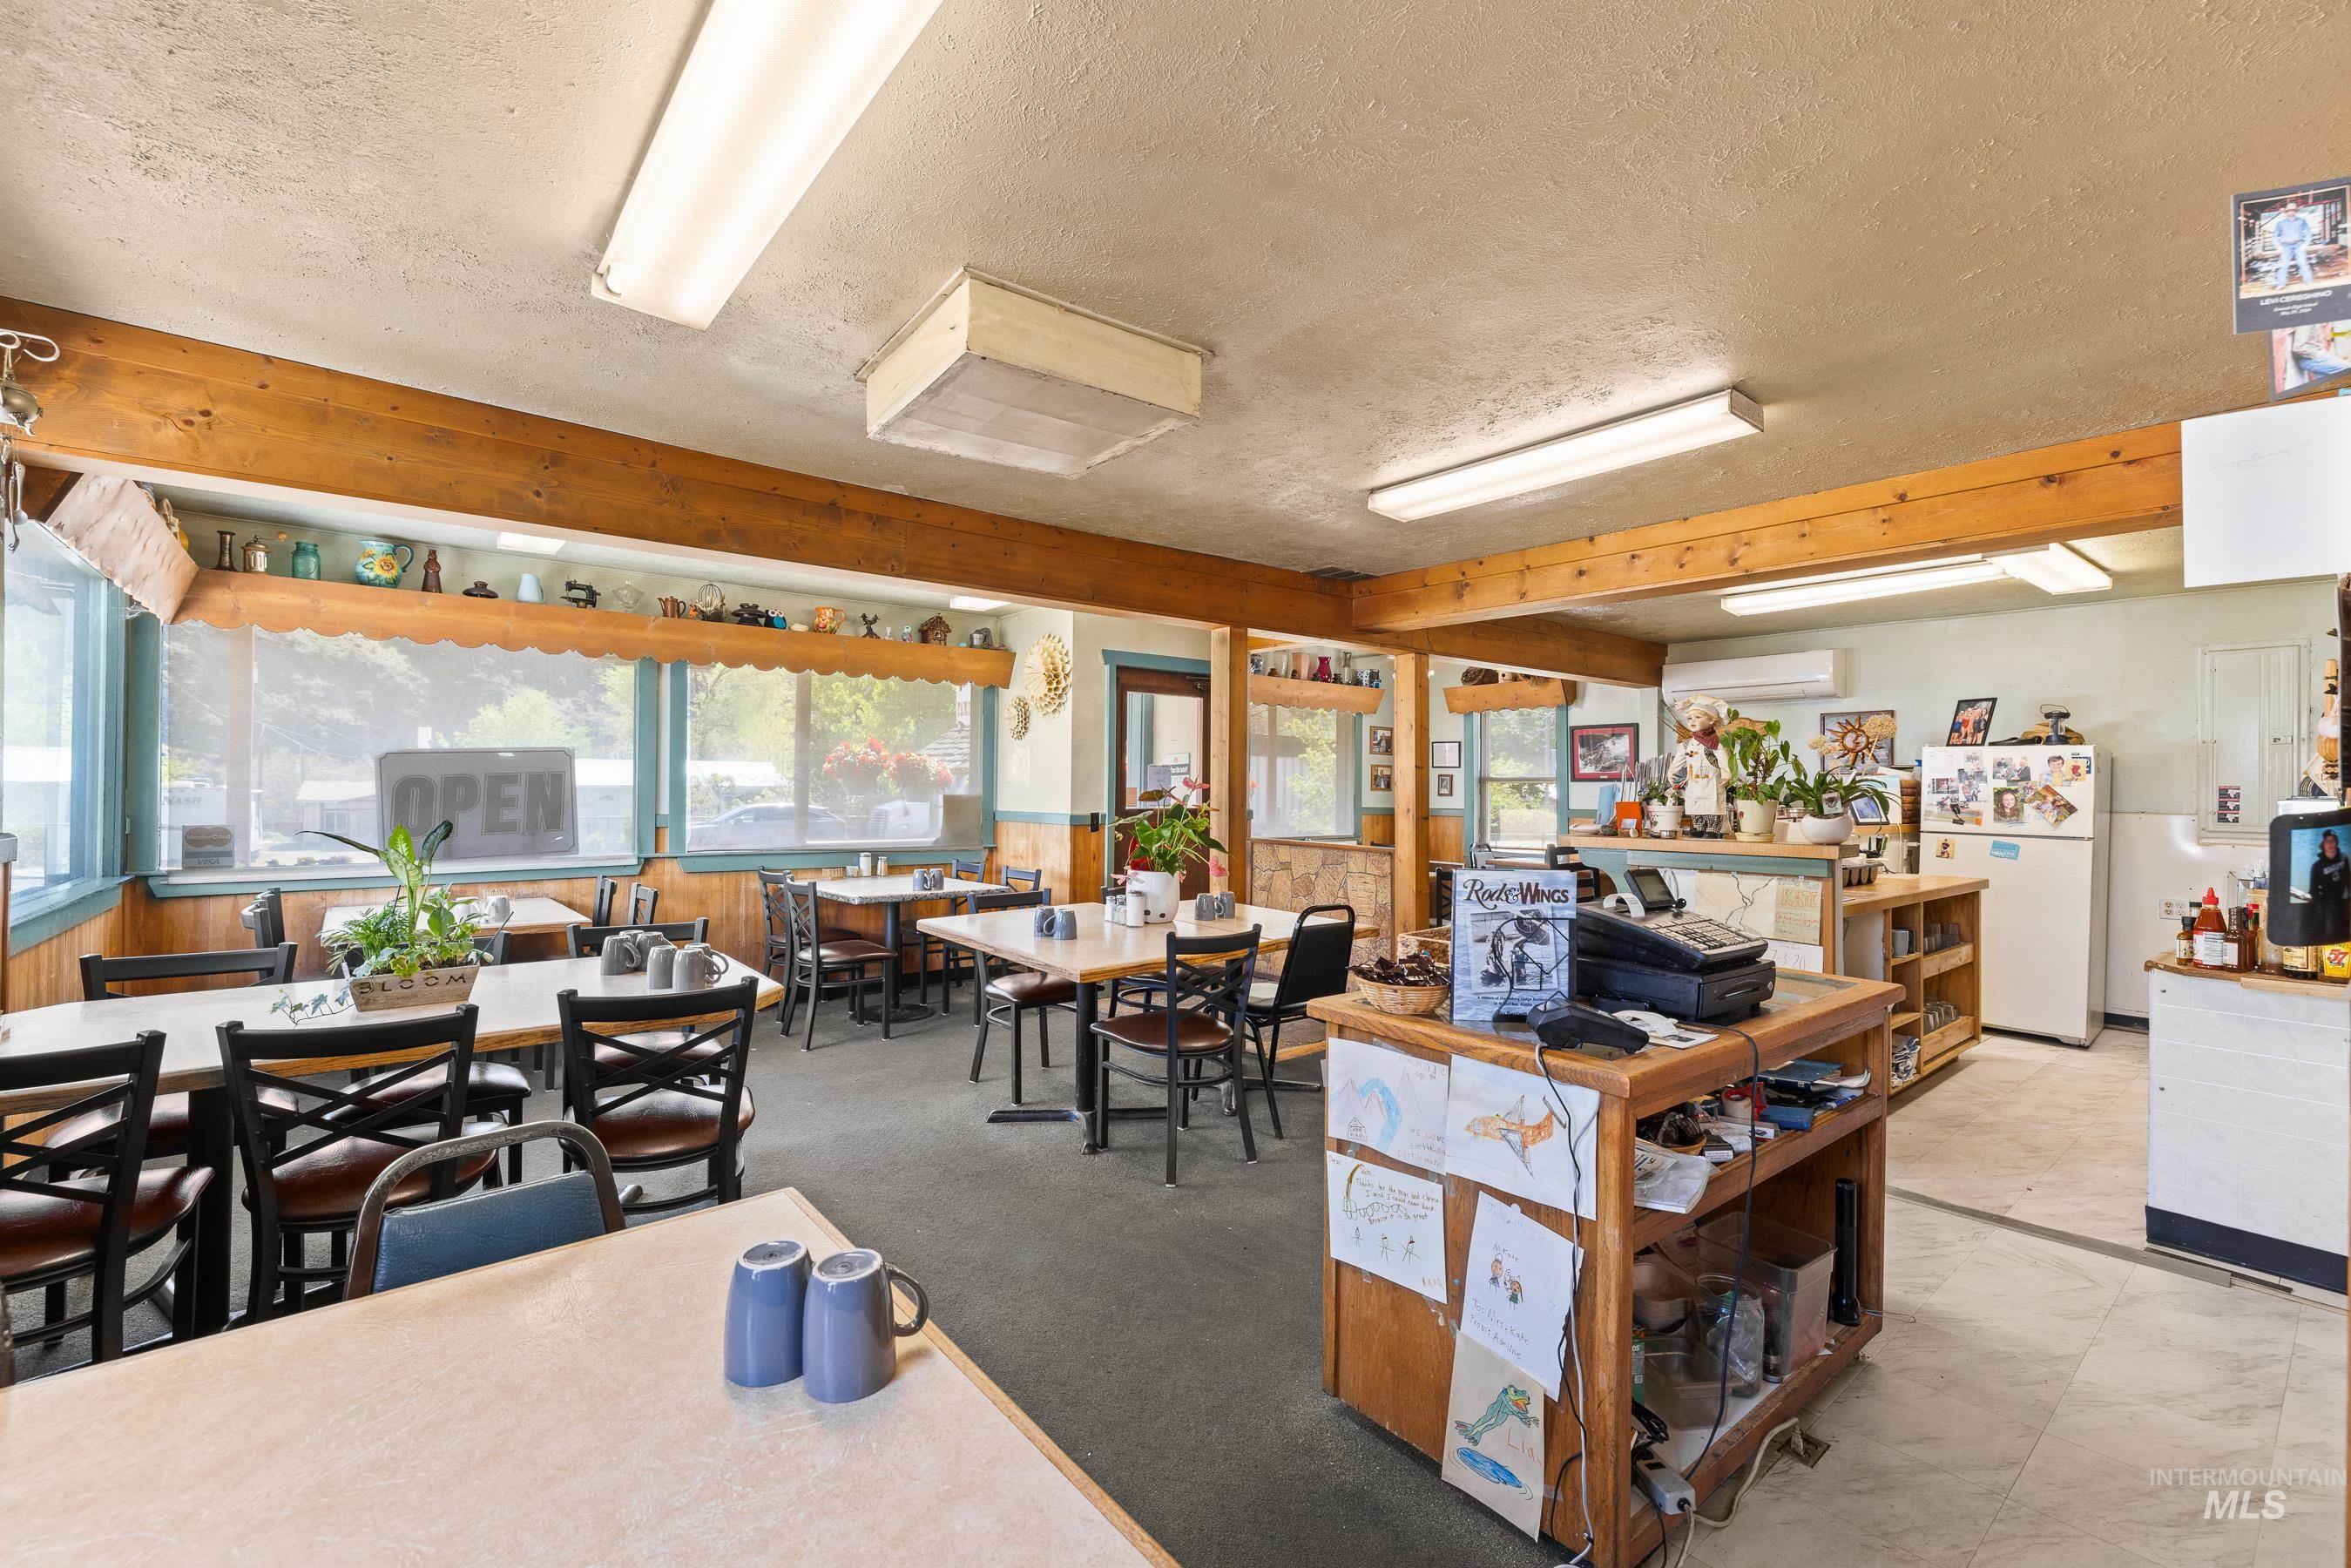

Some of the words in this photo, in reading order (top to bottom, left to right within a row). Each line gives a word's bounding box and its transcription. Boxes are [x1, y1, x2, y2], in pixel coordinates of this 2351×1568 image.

[390, 771, 566, 841] OPEN
[1463, 879, 1508, 910] Rods
[1781, 889, 1818, 907] KATE
[2327, 949, 2349, 963] 57
[359, 973, 467, 995] BLOOM
[1355, 1178, 1375, 1188] Thanks
[1470, 1314, 1490, 1336] From:
[1510, 1325, 1530, 1346] Kate
